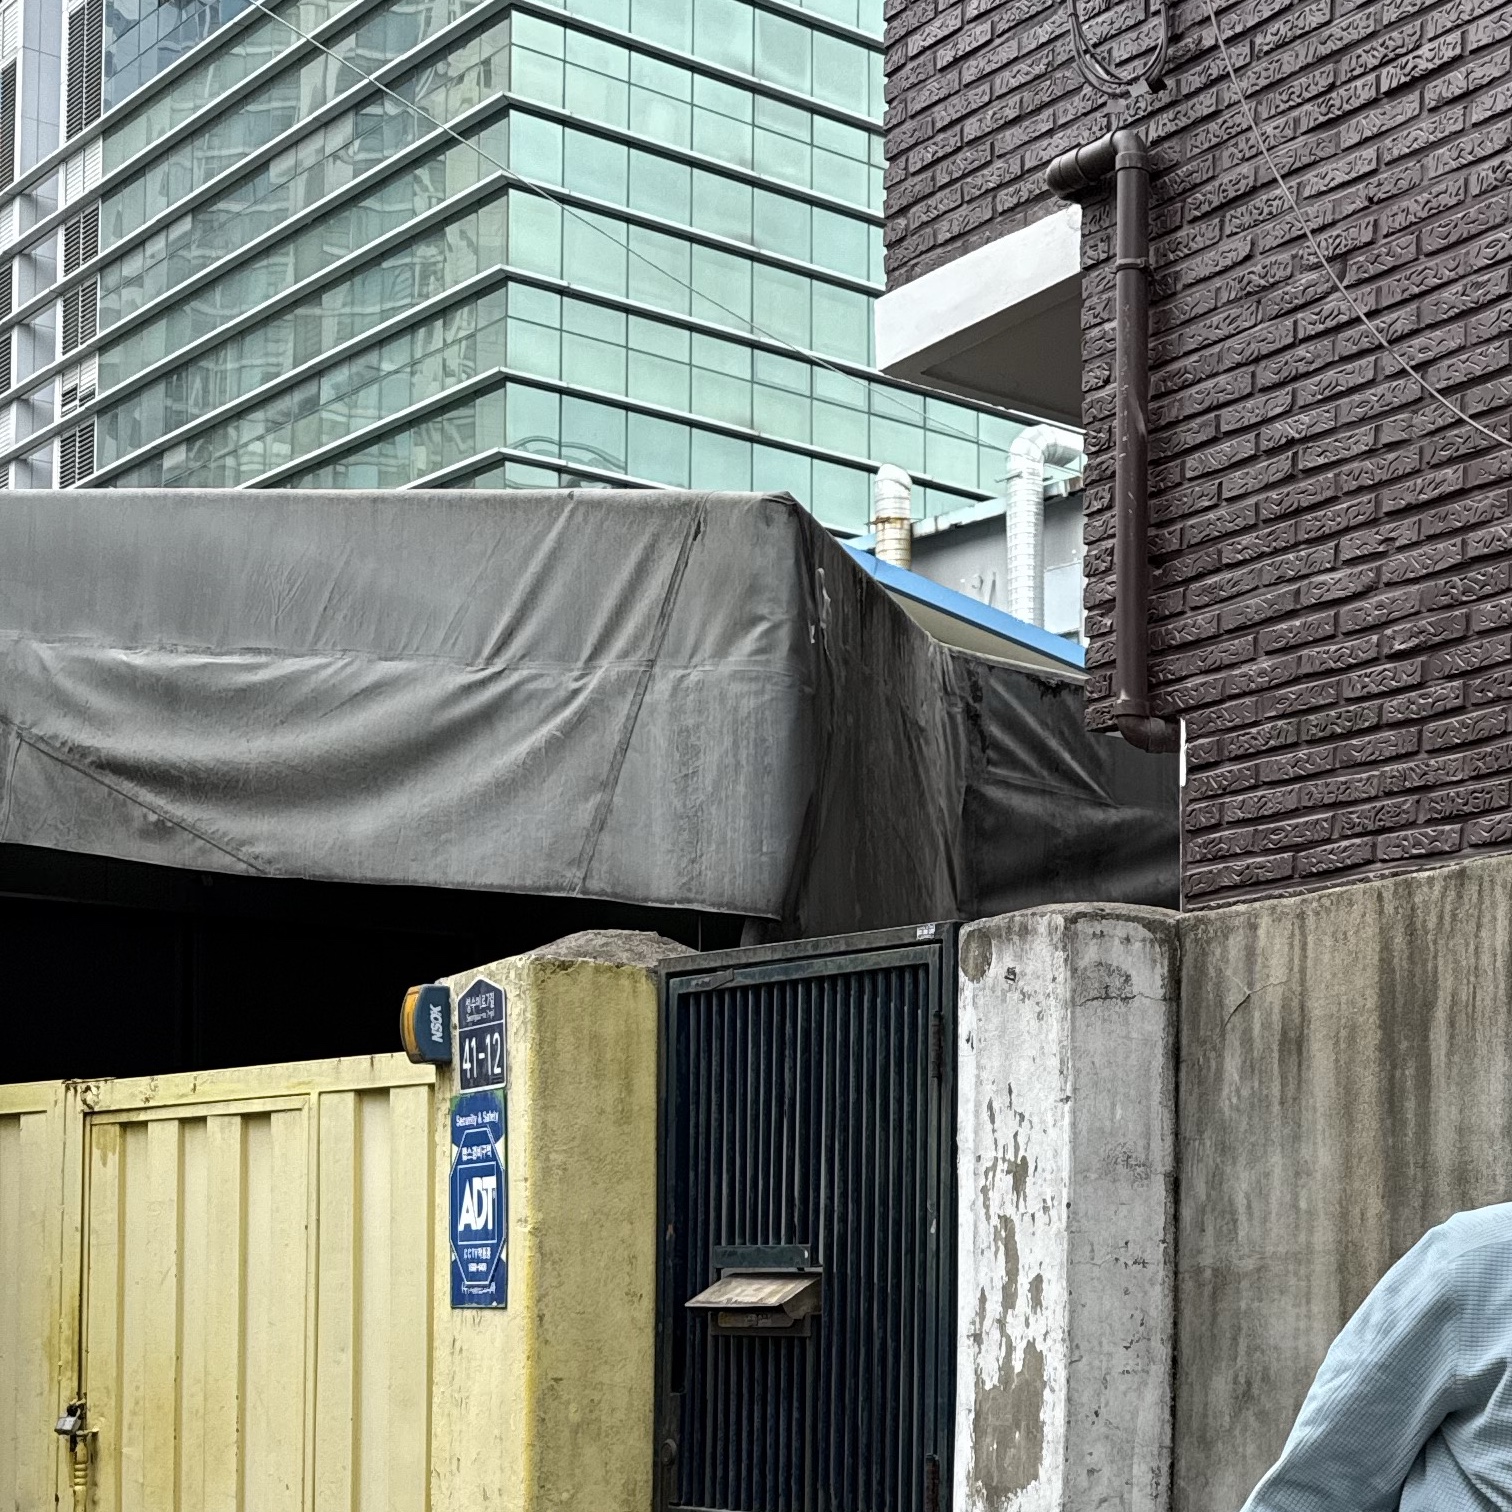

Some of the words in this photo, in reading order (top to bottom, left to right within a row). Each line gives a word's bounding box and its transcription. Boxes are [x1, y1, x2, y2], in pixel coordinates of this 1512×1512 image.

[429, 1003, 444, 1043] NSOK
[462, 1032, 502, 1078] 41-12
[456, 1113, 477, 1127] Security
[482, 1110, 499, 1123] Safety
[458, 1175, 496, 1231] ADT
